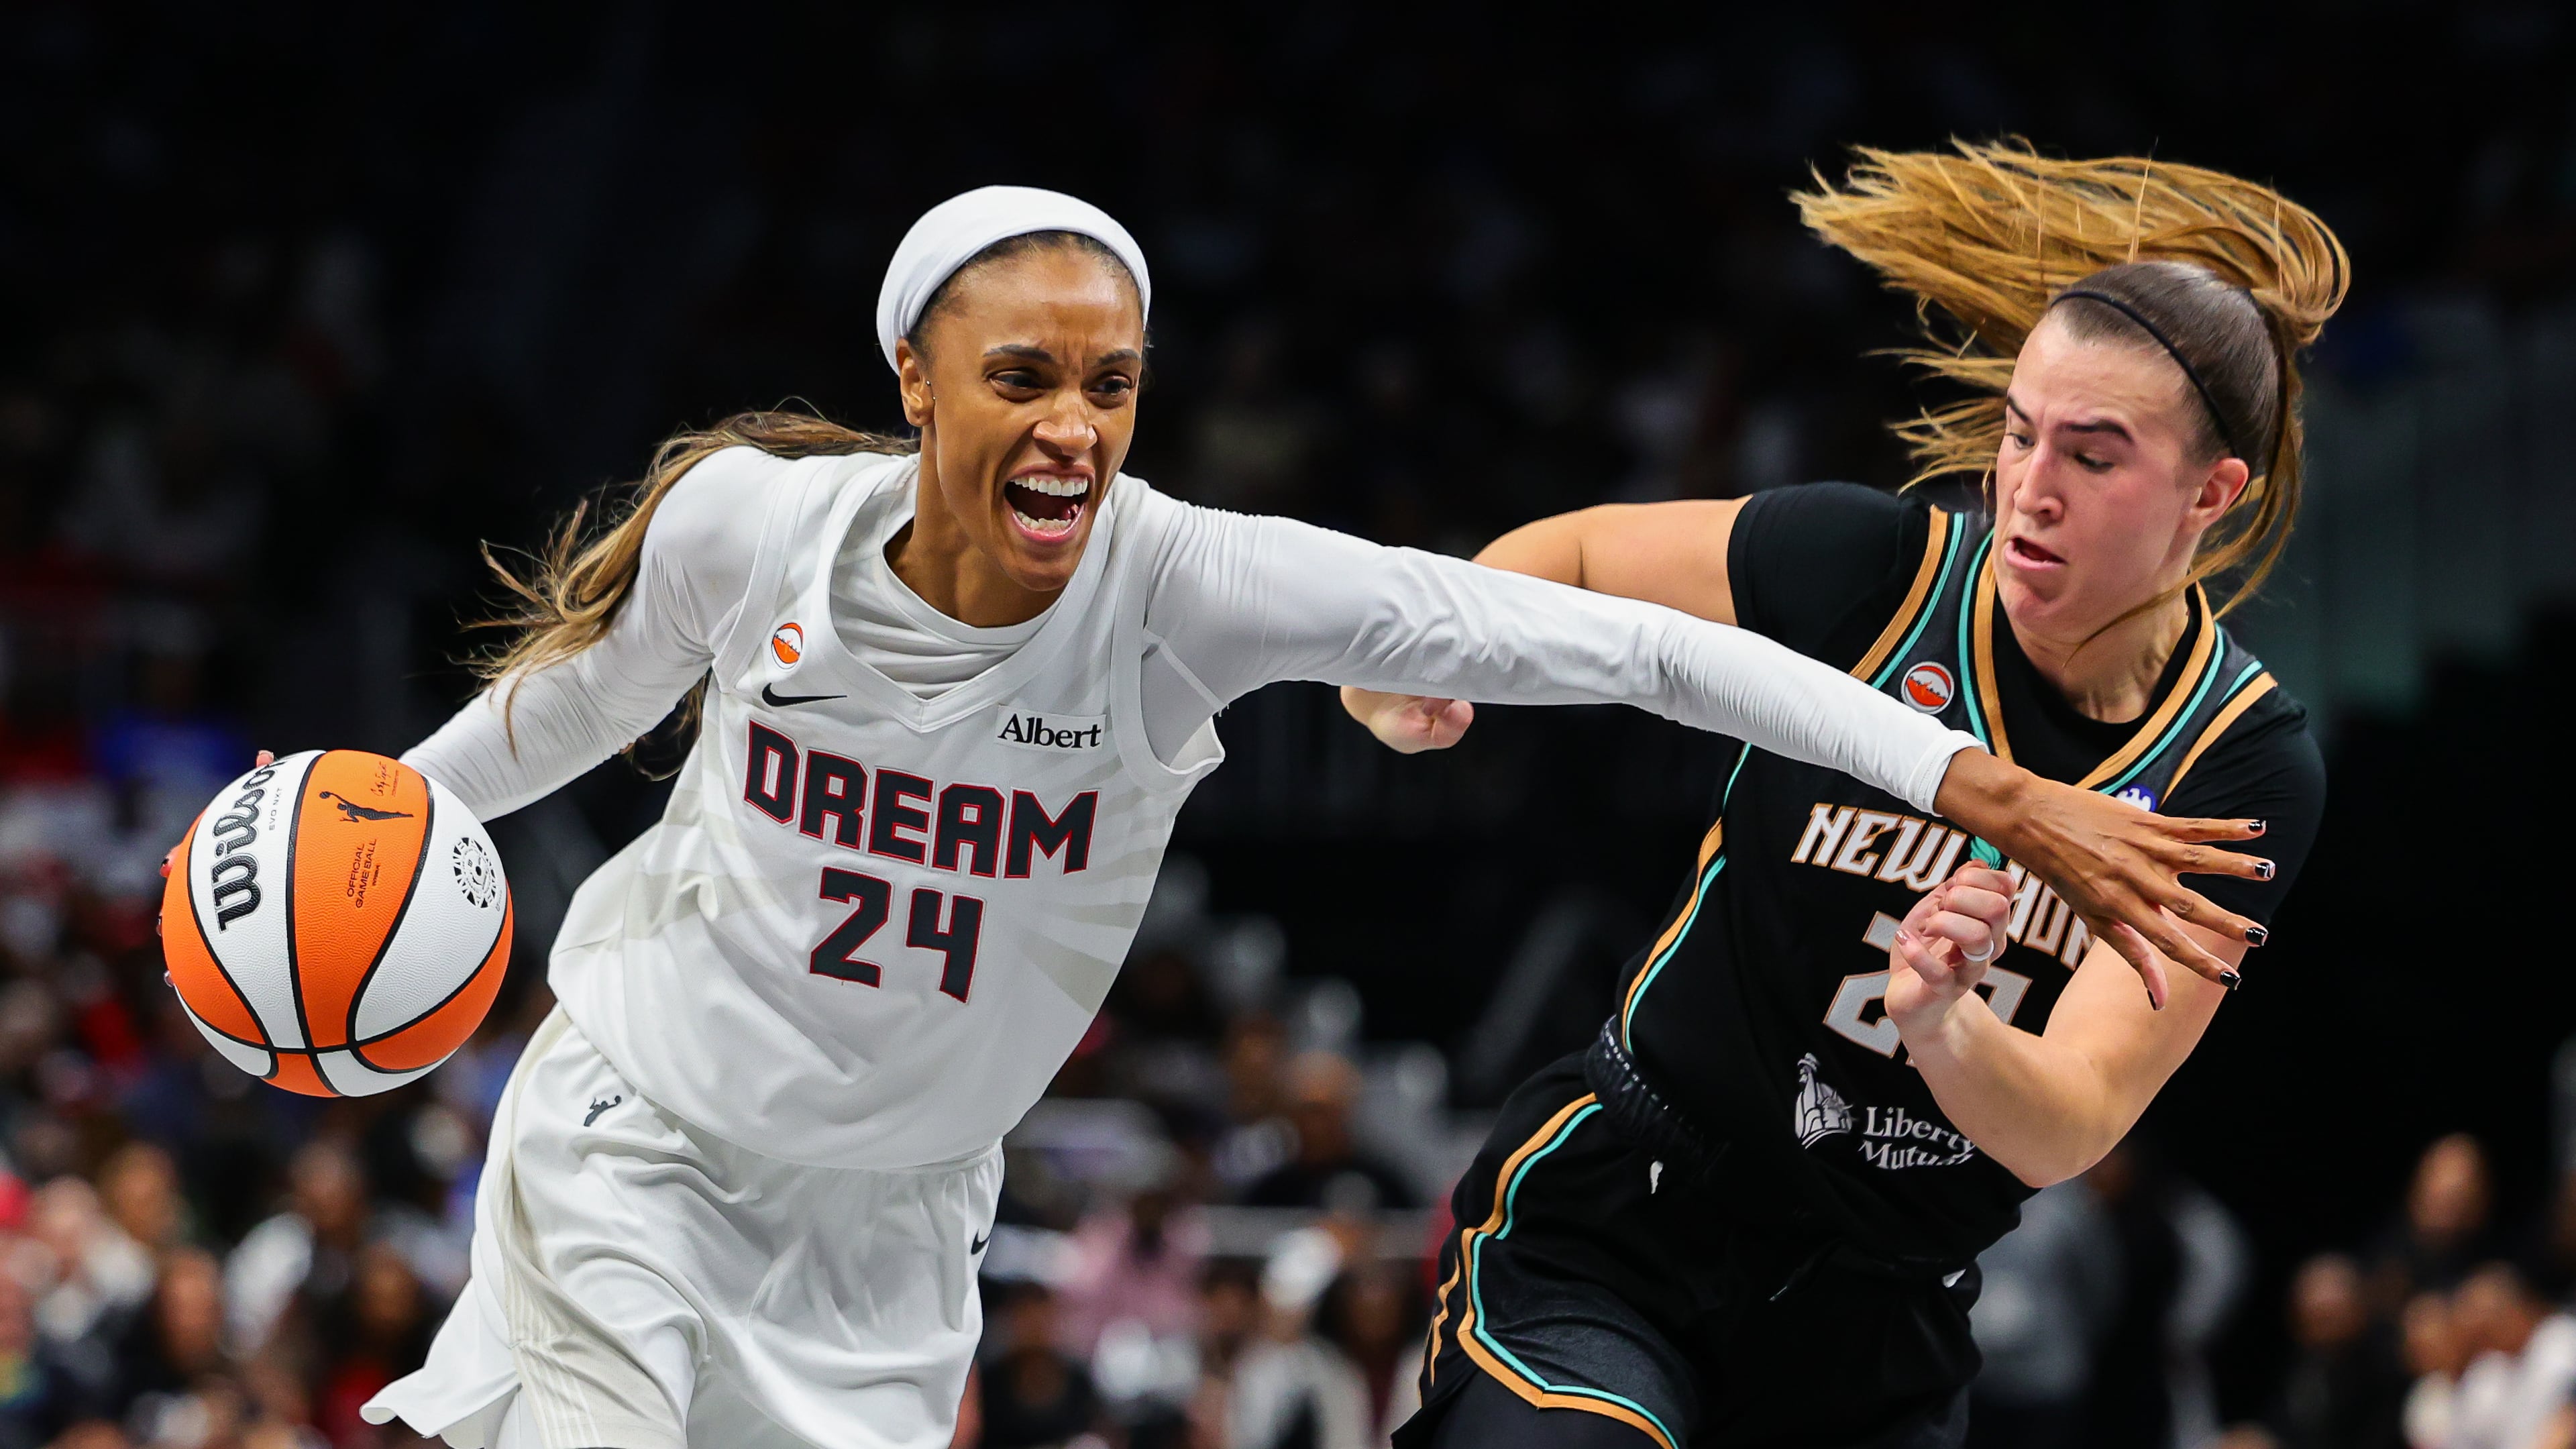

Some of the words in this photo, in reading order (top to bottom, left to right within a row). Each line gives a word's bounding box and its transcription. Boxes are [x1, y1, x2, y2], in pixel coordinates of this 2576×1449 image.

[998, 713, 1102, 749] Albert
[269, 810, 277, 830] EVO
[743, 718, 1100, 879] DREAM
[211, 761, 284, 932] Wilso
[347, 843, 365, 897] OFFICIAL
[356, 871, 370, 908] GAME
[364, 838, 377, 869] BALL
[1790, 802, 1968, 893] NEW
[810, 867, 985, 1004] 24
[1863, 1106, 1976, 1159] Liberty
